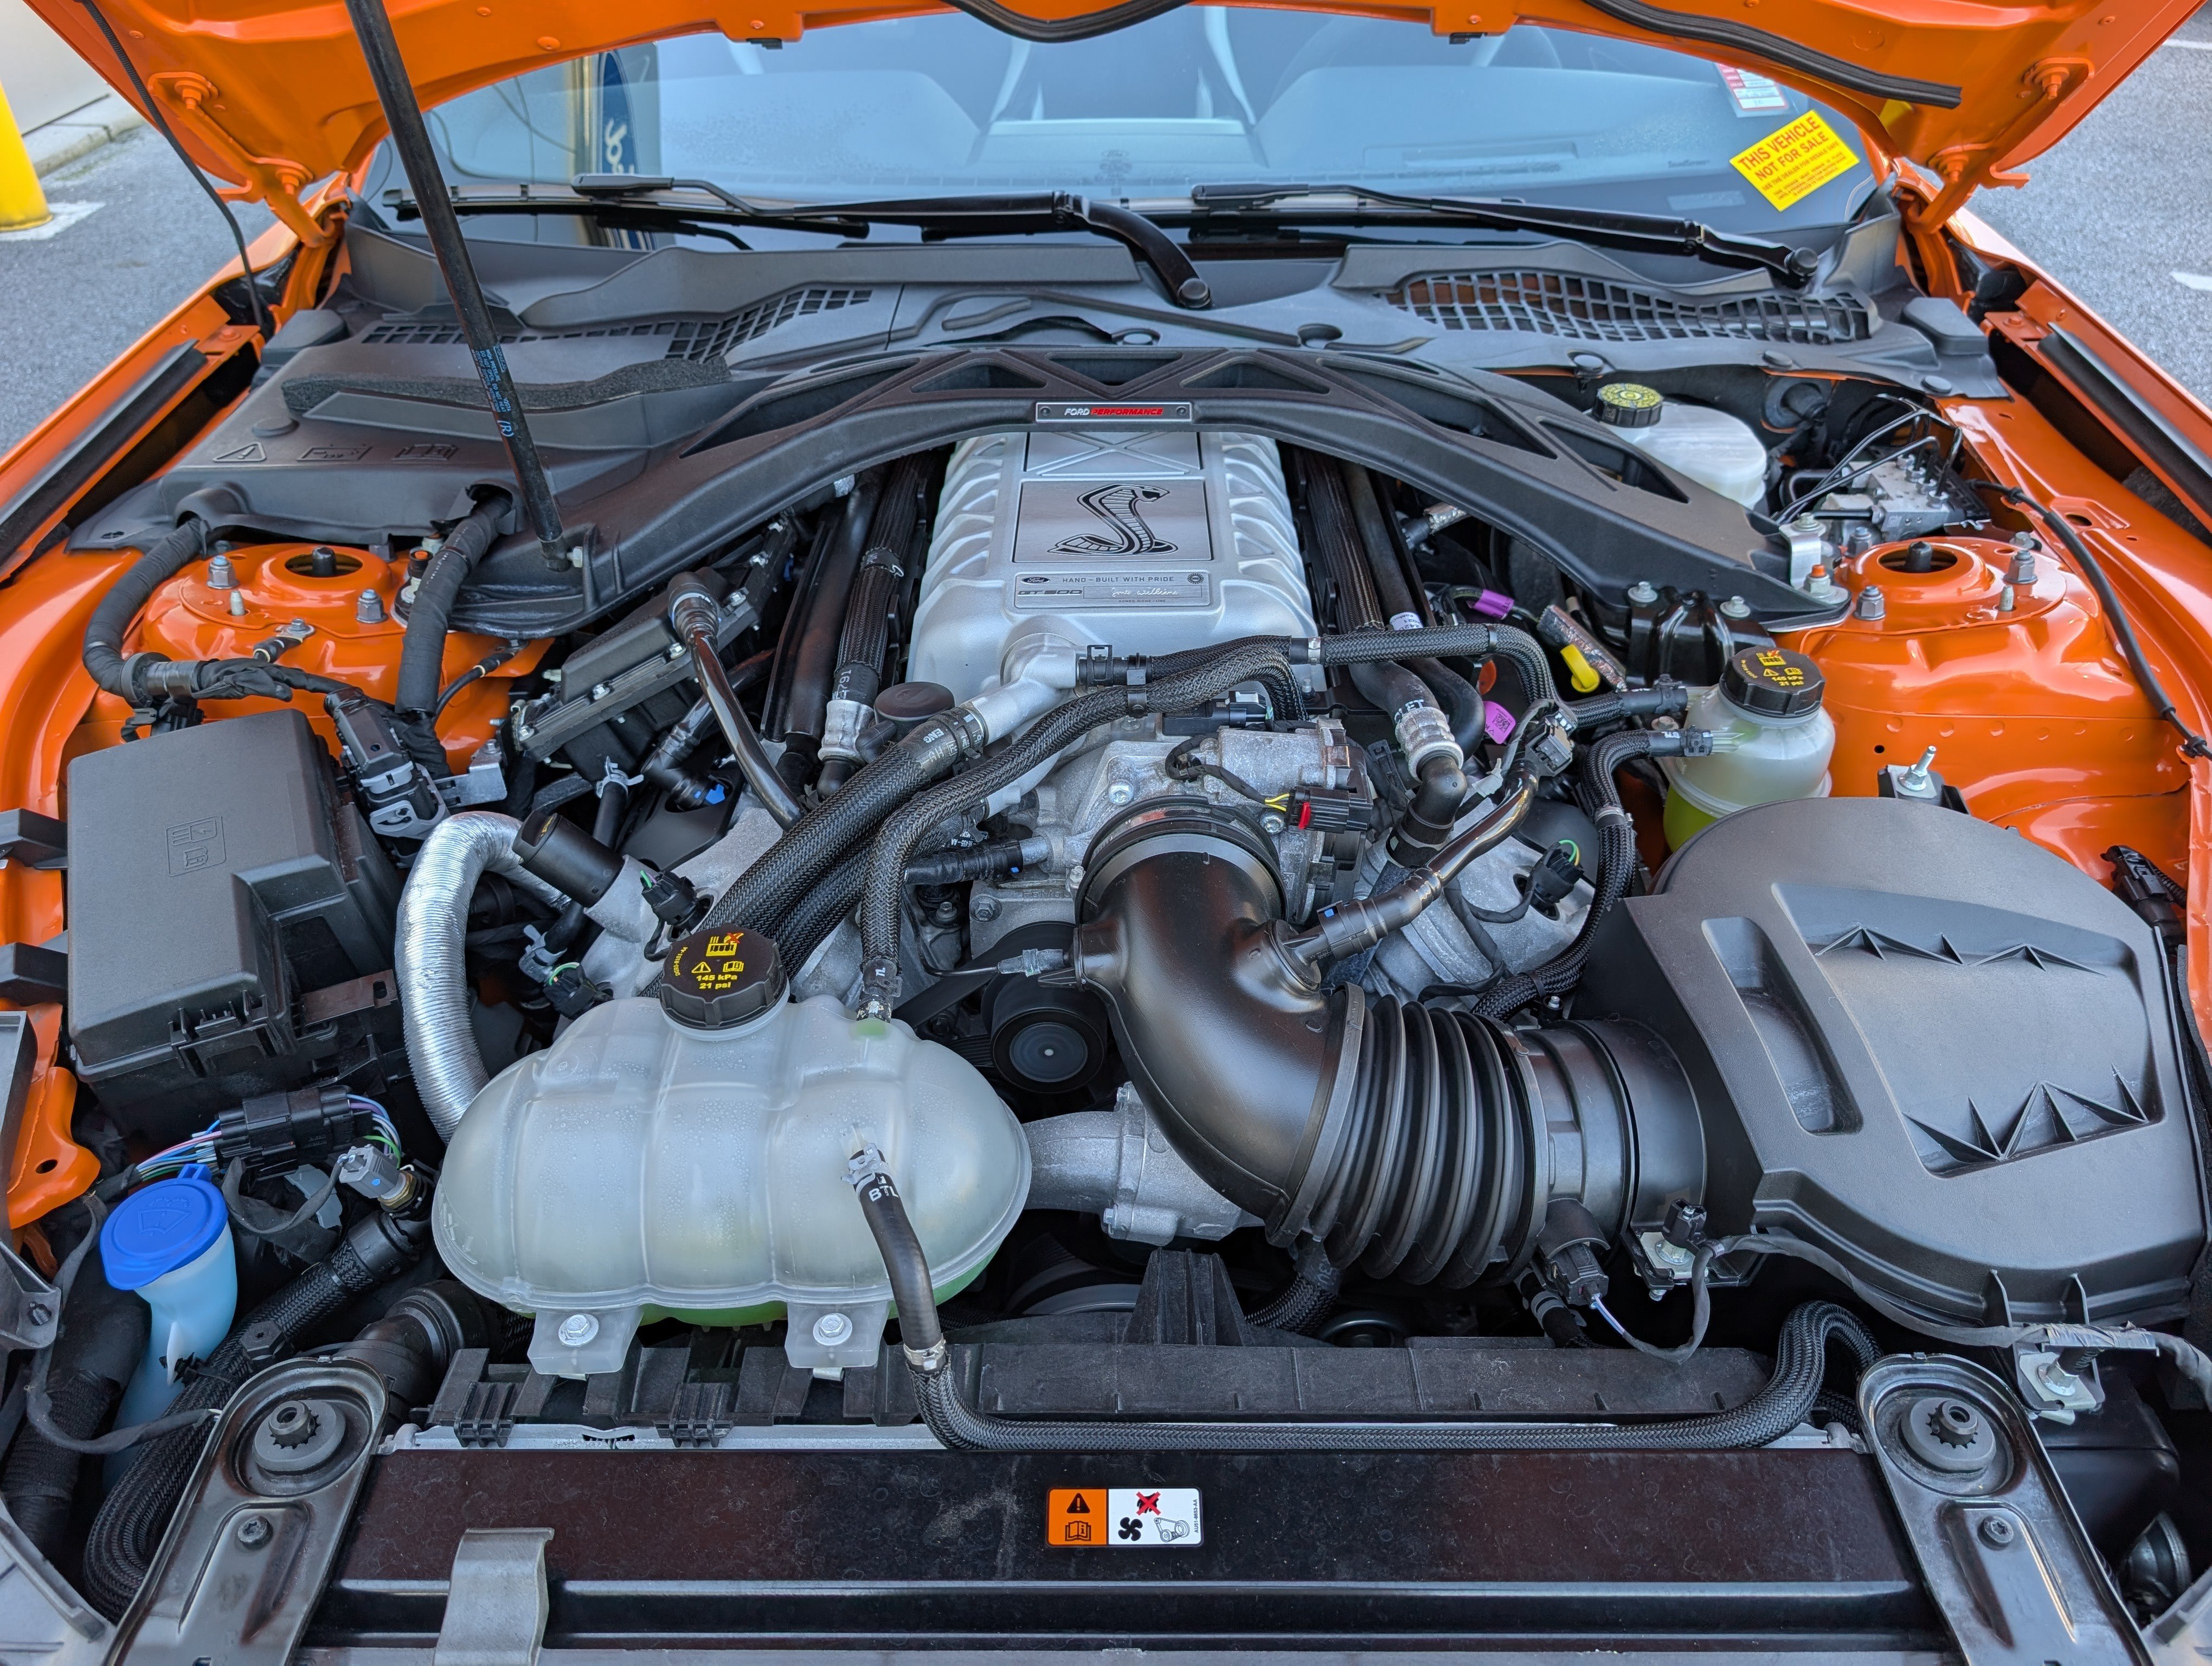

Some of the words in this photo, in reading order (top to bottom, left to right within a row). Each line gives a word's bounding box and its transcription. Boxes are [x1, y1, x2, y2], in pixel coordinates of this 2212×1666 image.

[1738, 148, 1770, 171] THIS
[1767, 117, 1821, 153] VEHICLE
[1754, 162, 1779, 181] NOT
[1778, 148, 1802, 168] FOR
[1799, 131, 1829, 153] SALE
[497, 420, 514, 437] (R)
[869, 1186, 899, 1202] BTL
